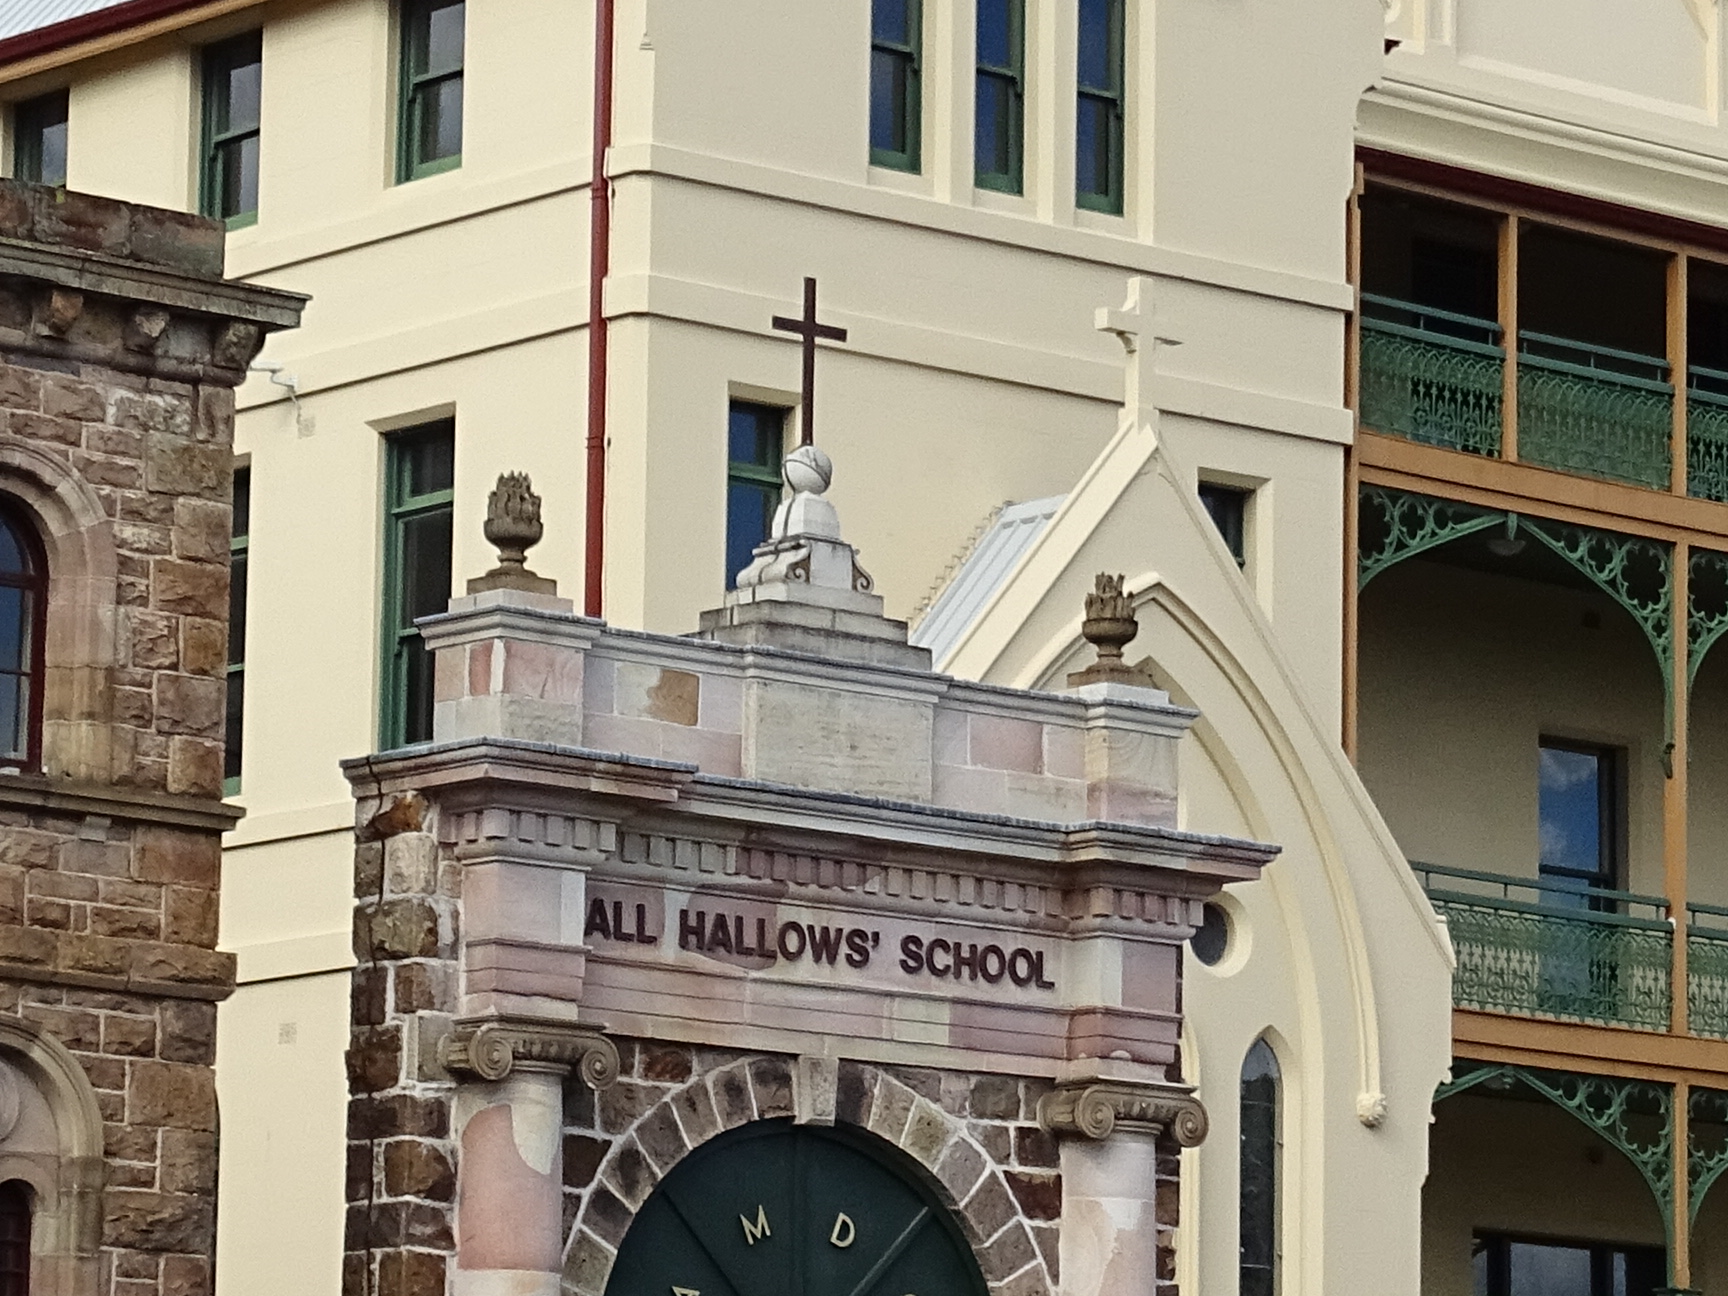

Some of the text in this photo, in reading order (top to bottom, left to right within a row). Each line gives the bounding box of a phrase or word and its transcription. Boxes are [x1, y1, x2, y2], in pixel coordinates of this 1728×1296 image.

[584, 897, 1056, 990] ALL HALLOWS' SCHOOL
[739, 1205, 772, 1245] M
[830, 1211, 857, 1249] D
